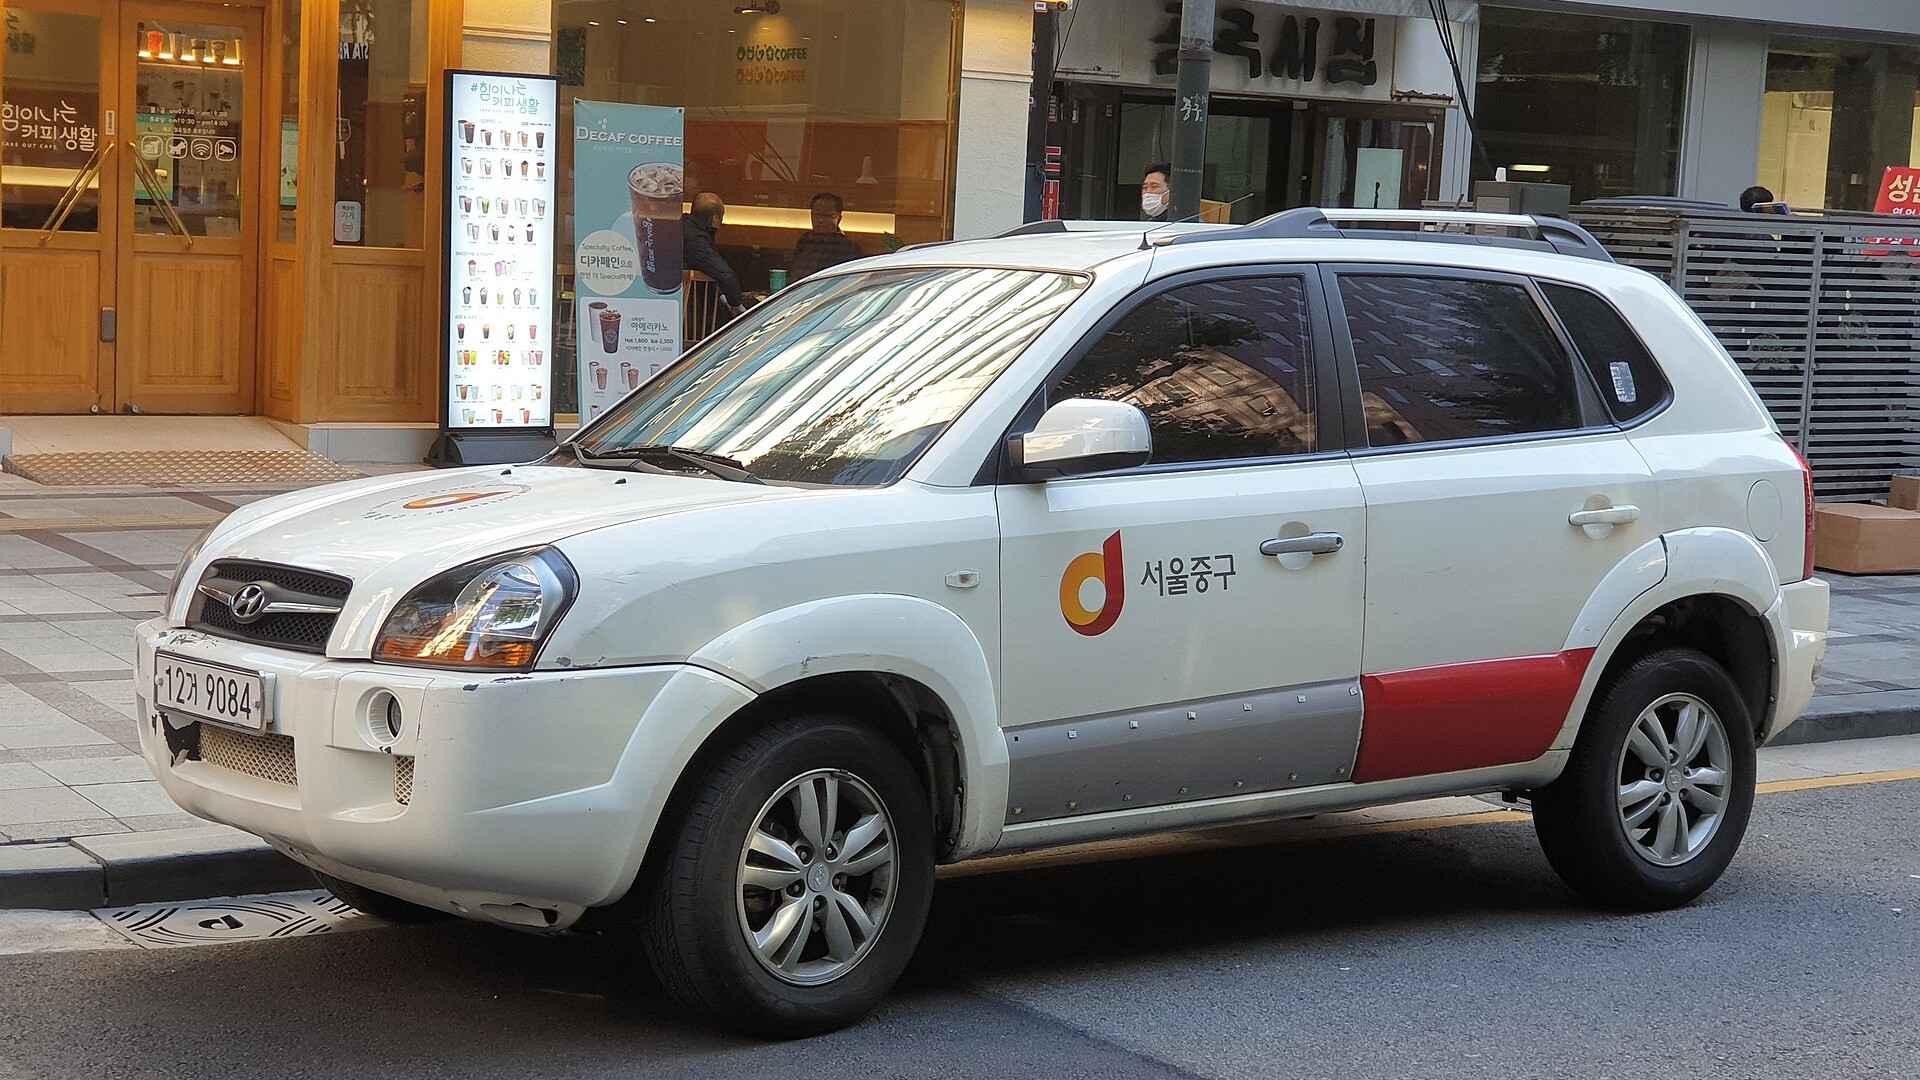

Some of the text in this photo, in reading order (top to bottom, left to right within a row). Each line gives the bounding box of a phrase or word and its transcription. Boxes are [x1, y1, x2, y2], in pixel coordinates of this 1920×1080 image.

[1, 100, 77, 132] 힘이나는
[492, 97, 540, 115] 커피생활
[21, 124, 98, 152] 커피생활
[629, 134, 682, 146] COFFEE
[631, 322, 669, 332] 아메리카노
[1140, 554, 1237, 597] 서울중구
[206, 673, 252, 721] 9084
